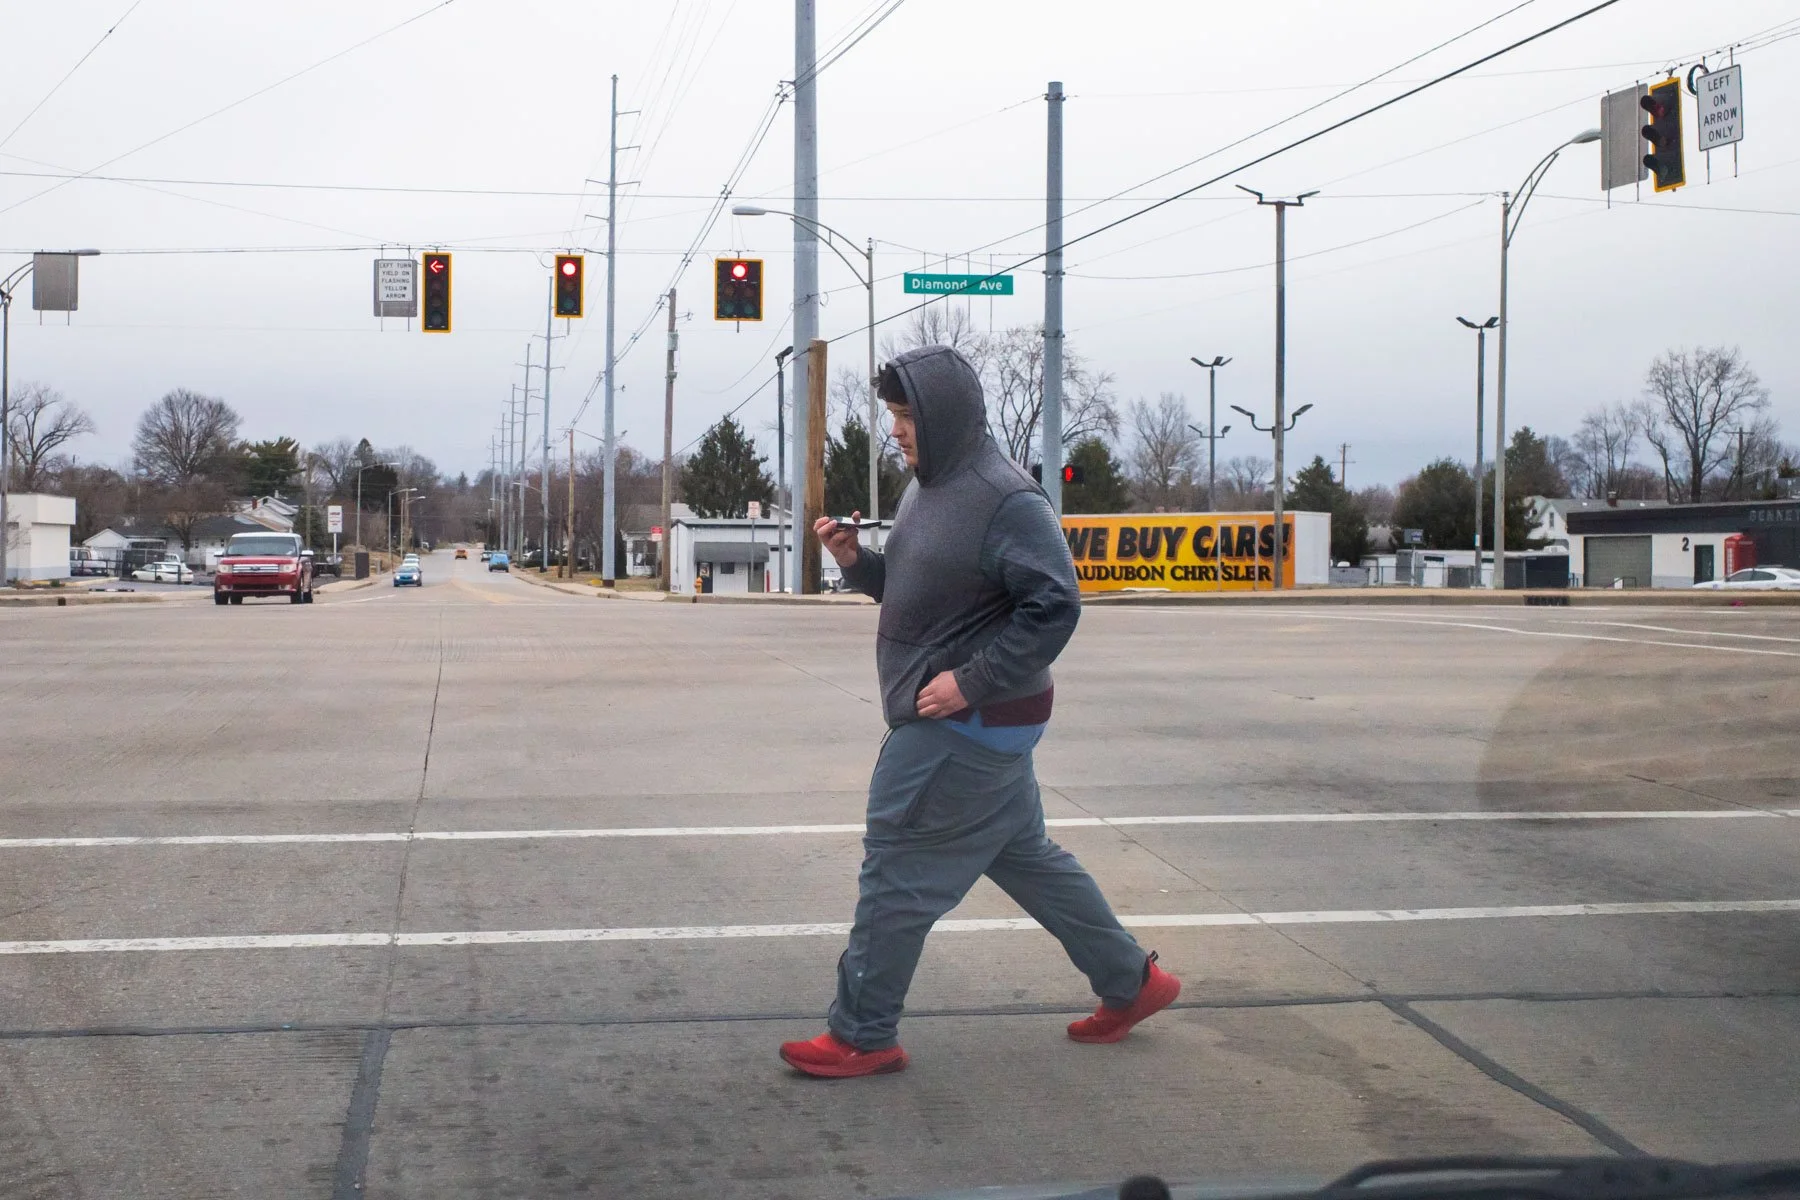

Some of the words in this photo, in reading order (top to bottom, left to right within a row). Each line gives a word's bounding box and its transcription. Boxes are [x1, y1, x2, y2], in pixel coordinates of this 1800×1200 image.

[1707, 74, 1731, 92] LEFT
[1713, 94, 1727, 107] ON
[1704, 106, 1738, 127] ARROW
[1708, 125, 1734, 142] ONLY
[911, 278, 968, 290] Diamond
[978, 280, 1003, 290] Ave
[1062, 527, 1109, 561] WE
[1117, 526, 1187, 561] BUY
[1192, 523, 1292, 561] CARS!
[1681, 536, 1690, 552] 2
[1076, 565, 1166, 582] AUDUBON
[1171, 565, 1273, 582] CHRYSLER
